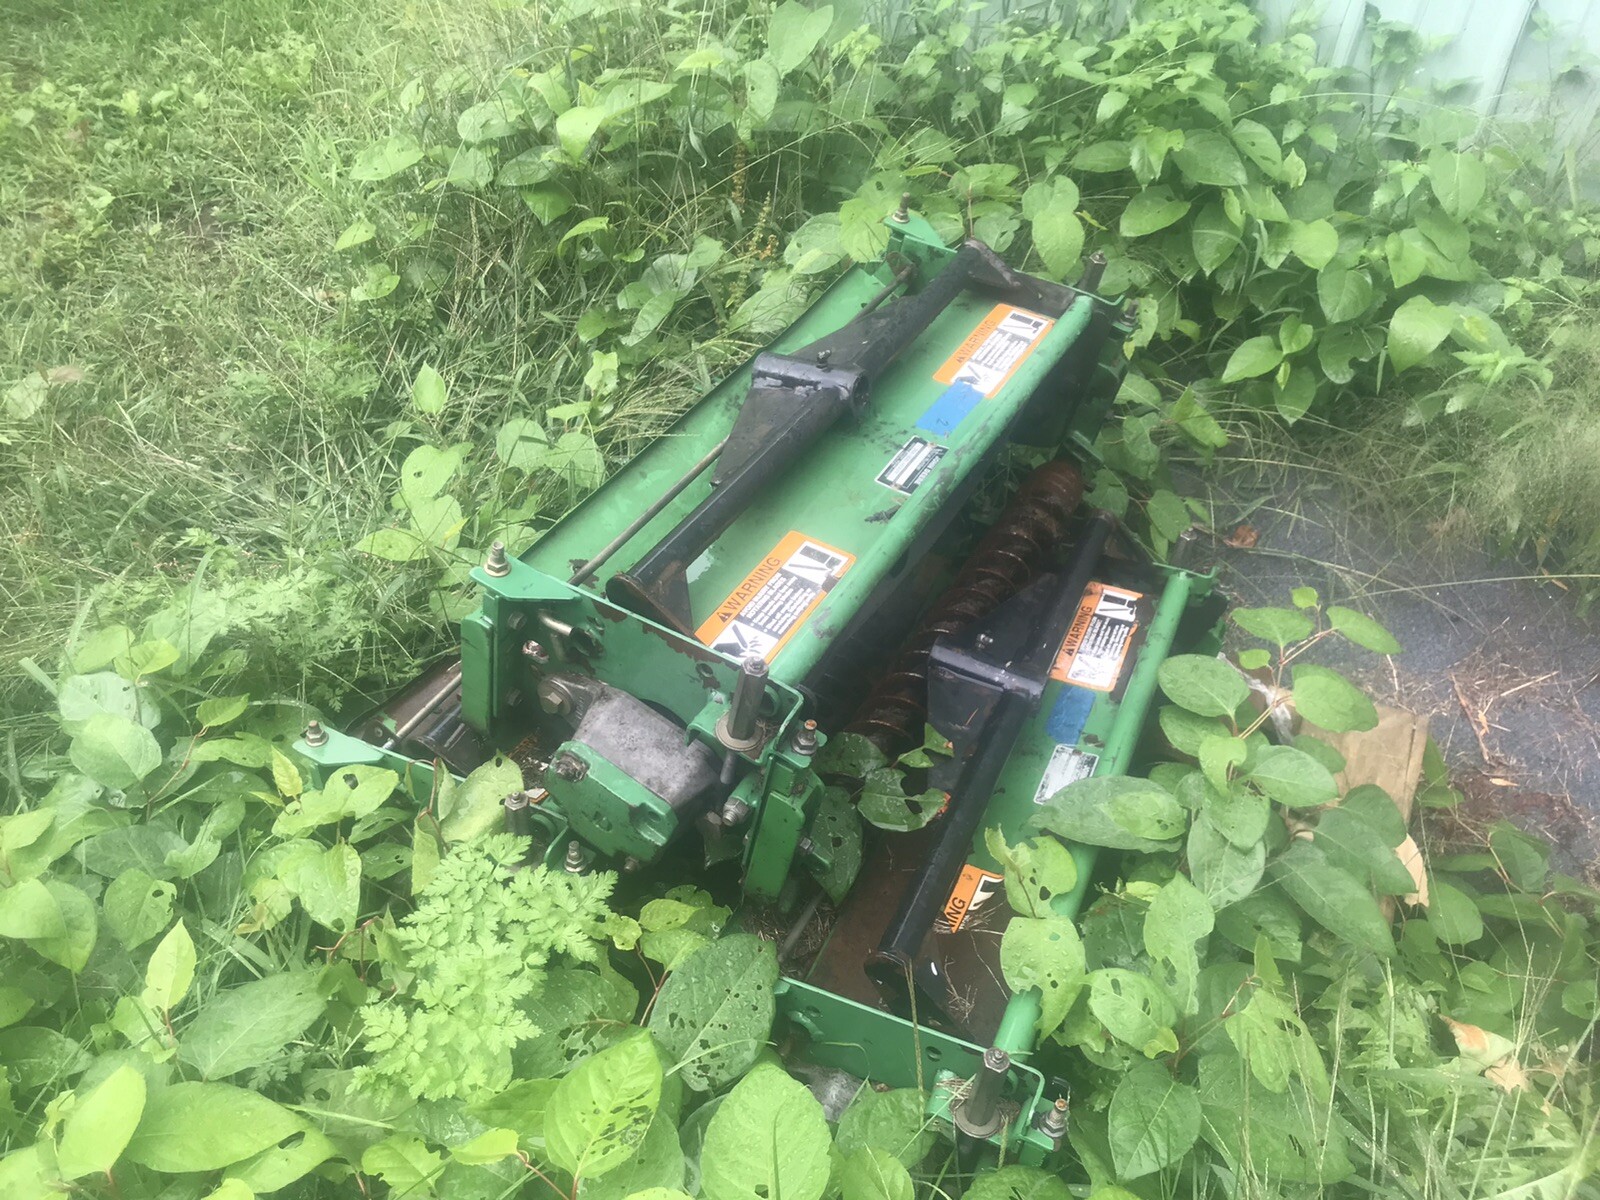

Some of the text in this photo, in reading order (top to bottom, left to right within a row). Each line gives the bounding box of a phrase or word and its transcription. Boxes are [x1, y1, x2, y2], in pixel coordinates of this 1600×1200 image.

[958, 318, 997, 355] WARNING
[724, 556, 781, 613] WARNING
[1066, 605, 1093, 647] WARNING
